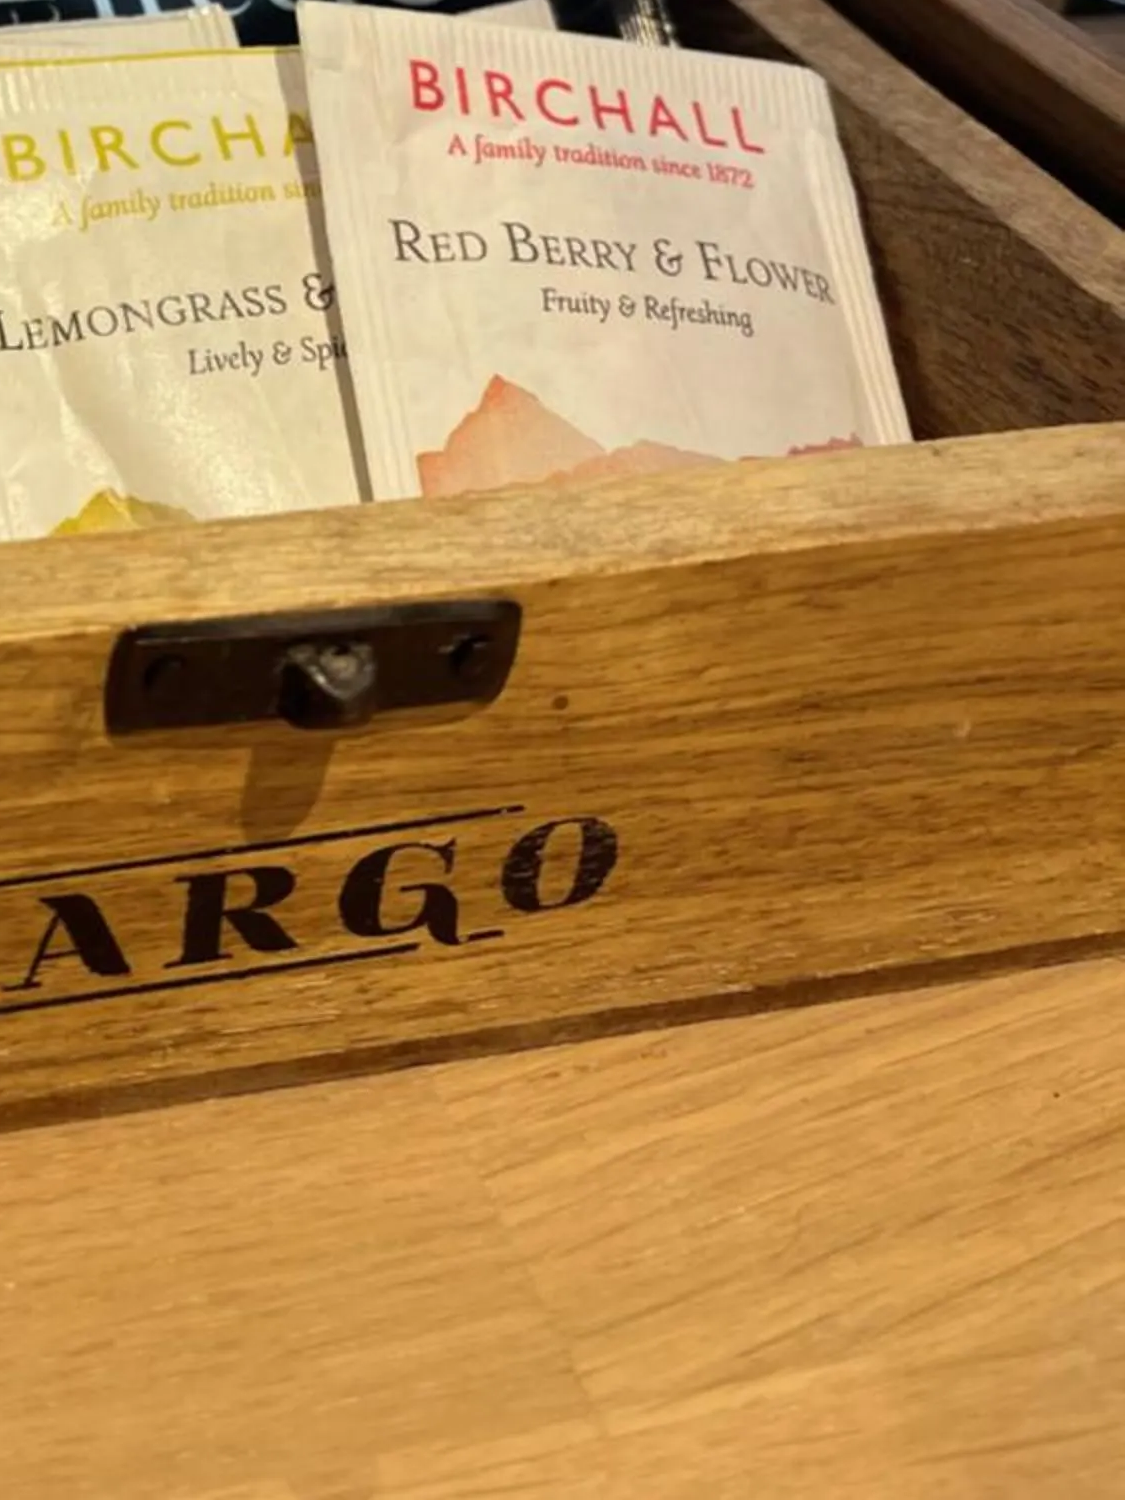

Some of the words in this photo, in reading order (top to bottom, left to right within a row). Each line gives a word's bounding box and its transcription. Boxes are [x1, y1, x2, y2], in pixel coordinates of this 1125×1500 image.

[409, 59, 766, 155] BIRCHALL
[447, 133, 467, 156] A
[473, 133, 547, 168] family
[553, 142, 648, 173] tradition
[651, 156, 703, 180] since
[706, 161, 756, 190] 1872
[78, 188, 162, 233] family
[167, 179, 276, 212] tradition
[389, 219, 488, 264] RED
[500, 221, 637, 273] BERRY
[653, 237, 684, 277] &
[302, 272, 336, 312] &
[540, 286, 612, 325] Fruity
[618, 295, 637, 318] &
[644, 294, 755, 338] Refreshing
[187, 339, 265, 378] Lively
[272, 340, 293, 366] &
